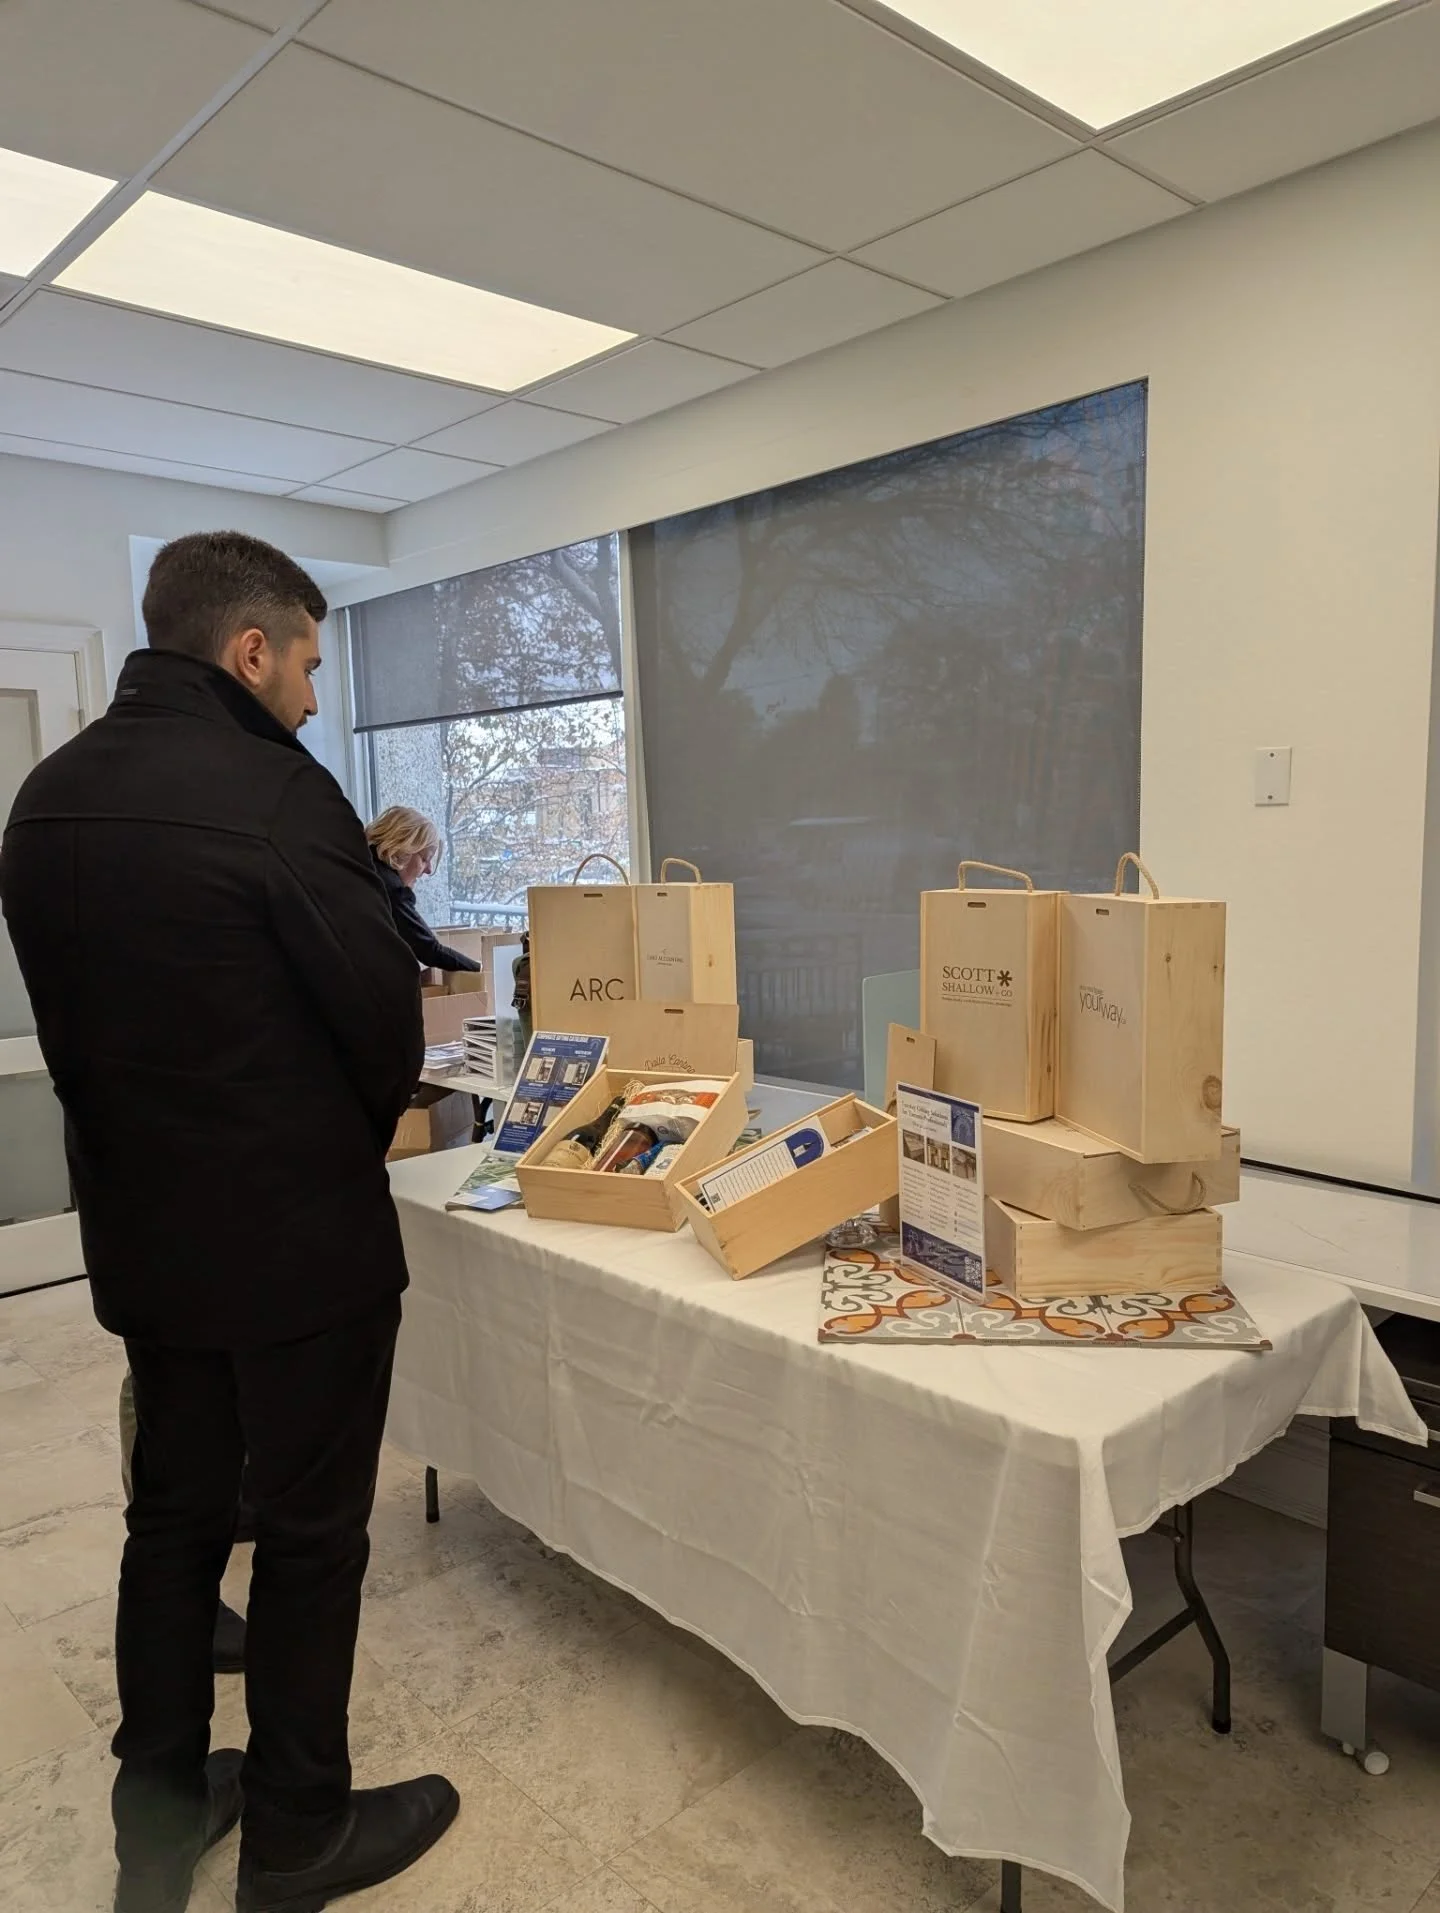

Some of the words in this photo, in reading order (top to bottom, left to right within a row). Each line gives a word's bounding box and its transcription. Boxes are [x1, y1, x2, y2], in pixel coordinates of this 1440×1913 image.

[942, 965, 996, 982] SCOTT
[569, 977, 624, 1001] ARC
[942, 981, 995, 995] SHALLOW
